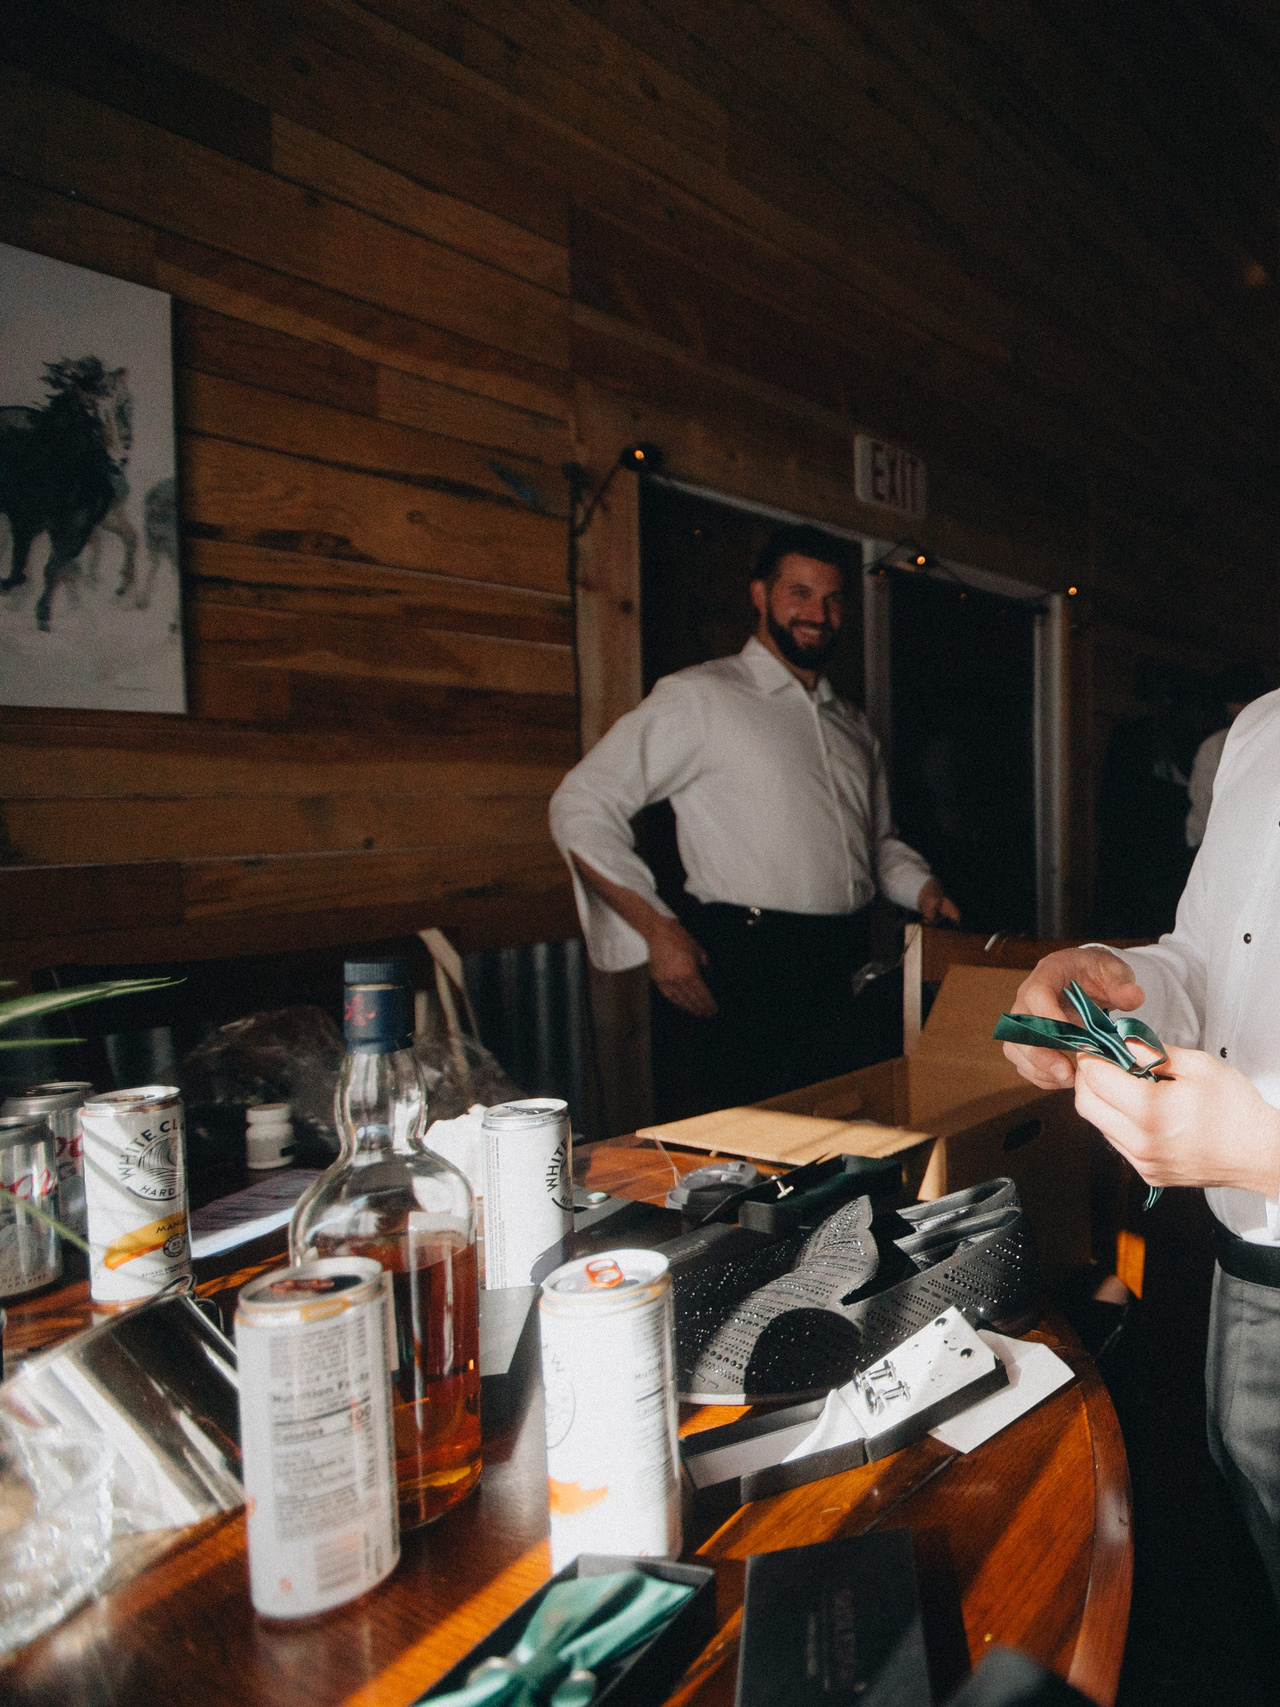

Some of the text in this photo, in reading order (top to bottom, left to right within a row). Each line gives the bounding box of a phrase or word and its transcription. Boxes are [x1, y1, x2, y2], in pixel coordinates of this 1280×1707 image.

[871, 441, 921, 512] EXIT
[118, 1129, 157, 1181] WHITE
[140, 1184, 176, 1198] HARD
